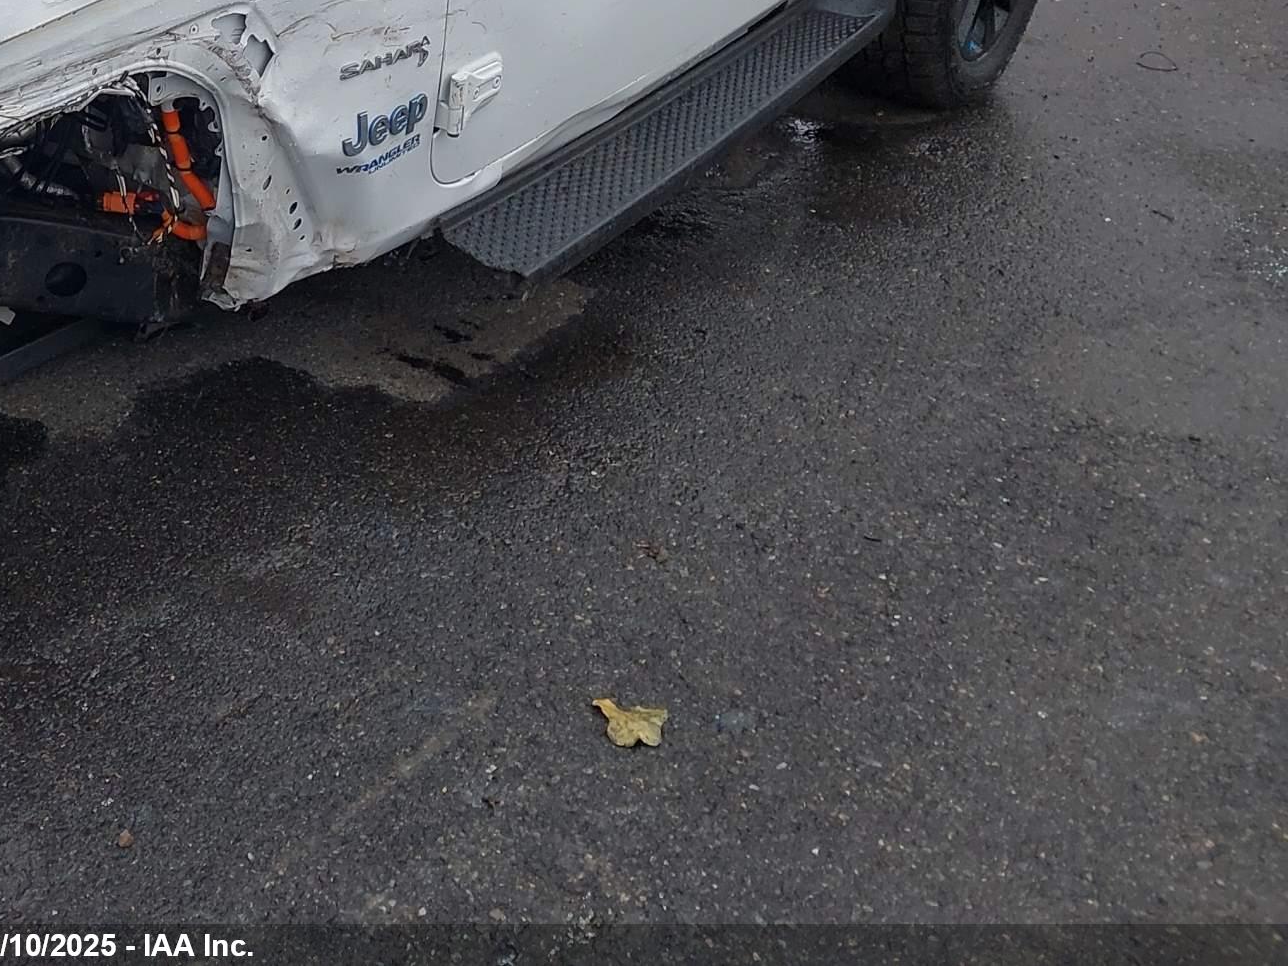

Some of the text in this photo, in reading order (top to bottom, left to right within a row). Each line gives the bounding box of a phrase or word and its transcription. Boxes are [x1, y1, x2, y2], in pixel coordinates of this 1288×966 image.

[339, 35, 431, 81] SAHARA
[342, 93, 429, 157] Jeep
[336, 133, 421, 174] WRANGLER
